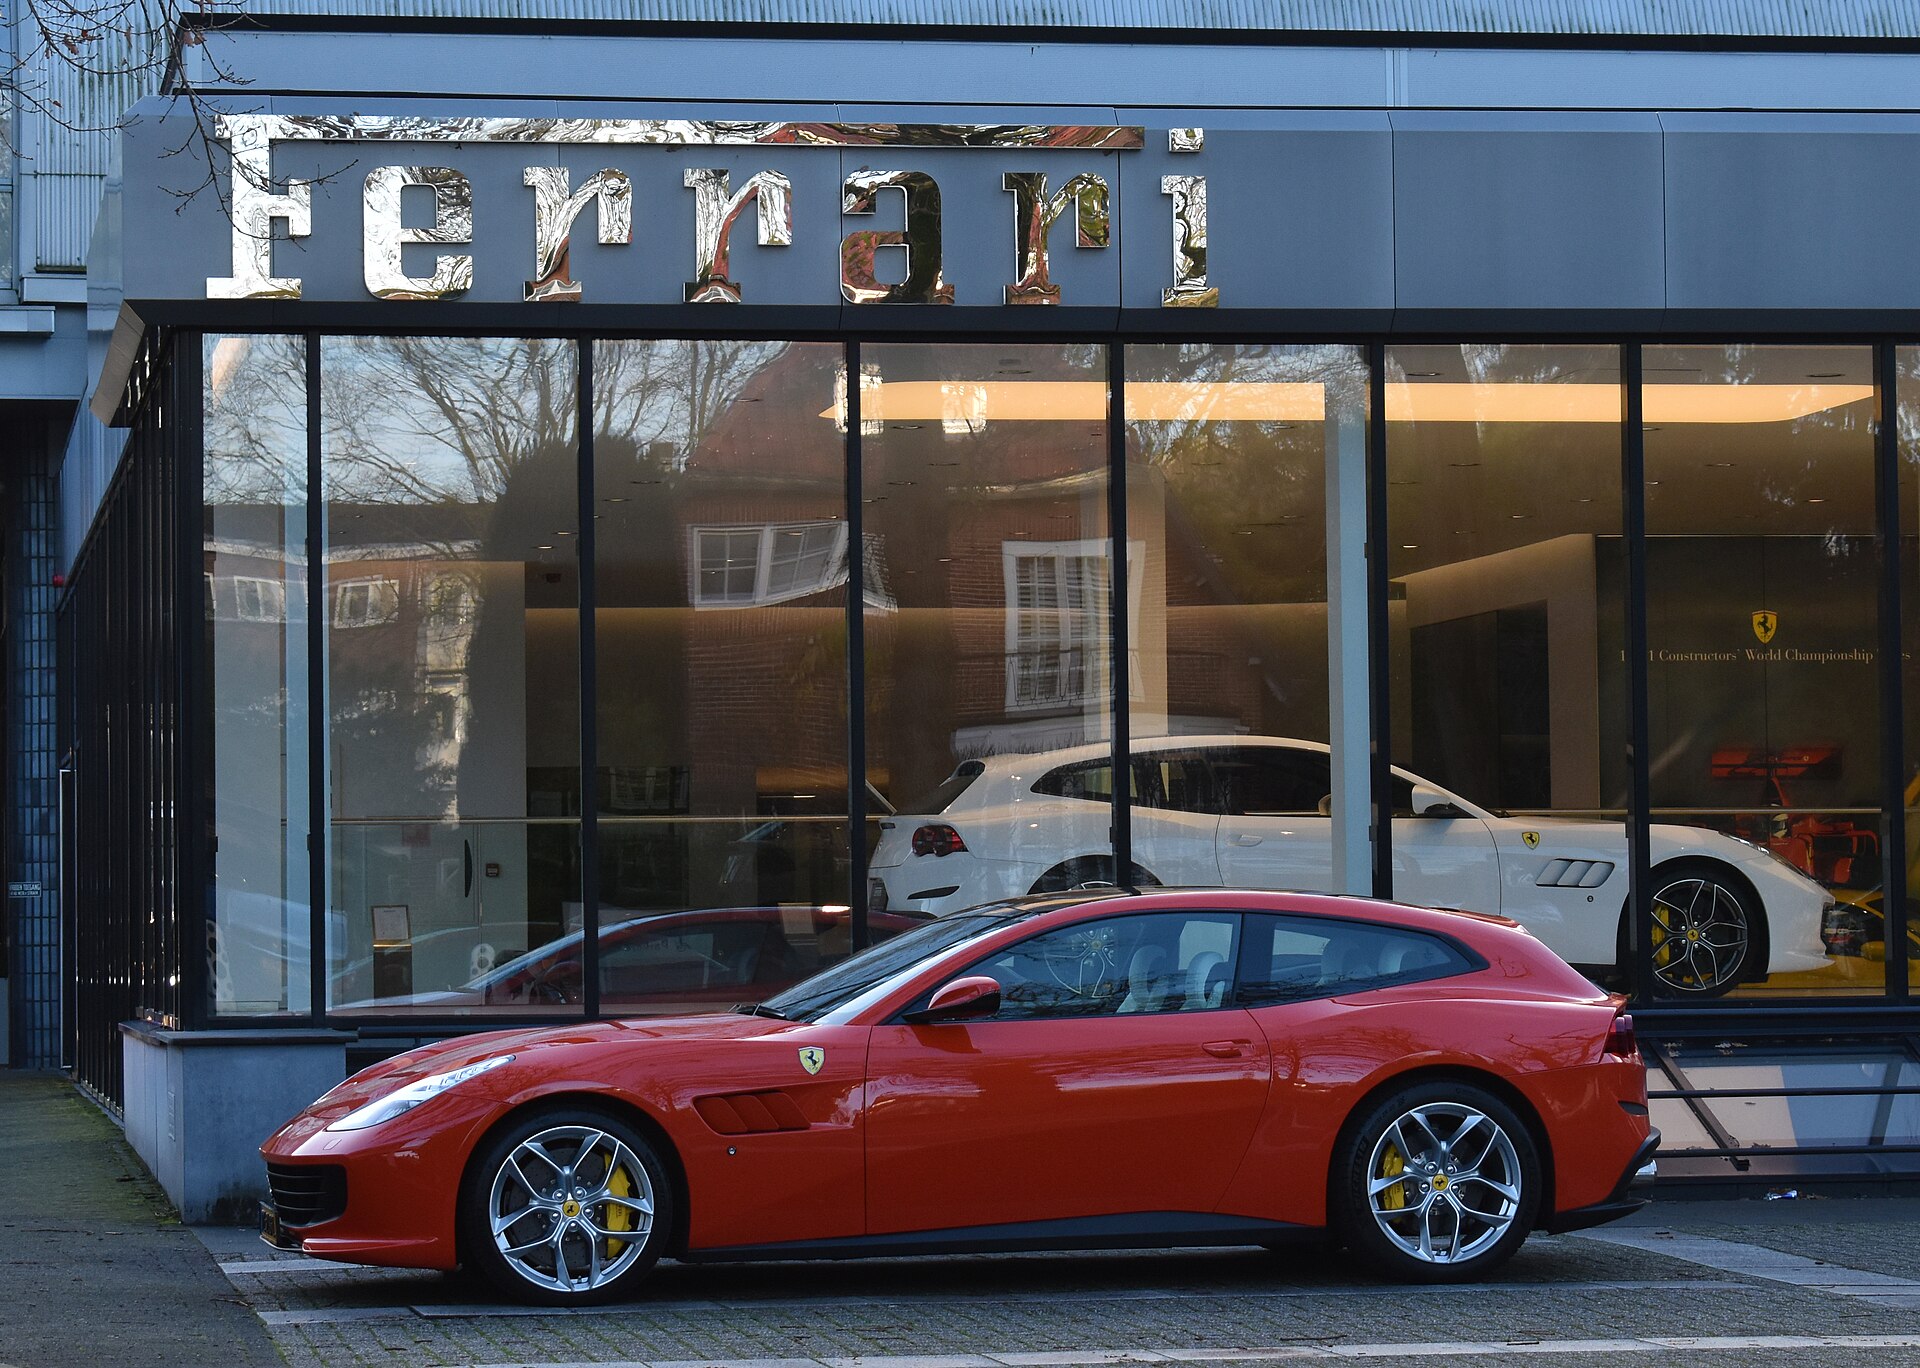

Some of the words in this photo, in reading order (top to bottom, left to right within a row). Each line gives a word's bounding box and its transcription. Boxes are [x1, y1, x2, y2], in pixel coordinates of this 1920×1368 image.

[205, 113, 1219, 307] Ferrari
[1745, 648, 1781, 661] World
[1785, 648, 1874, 664] Championship
